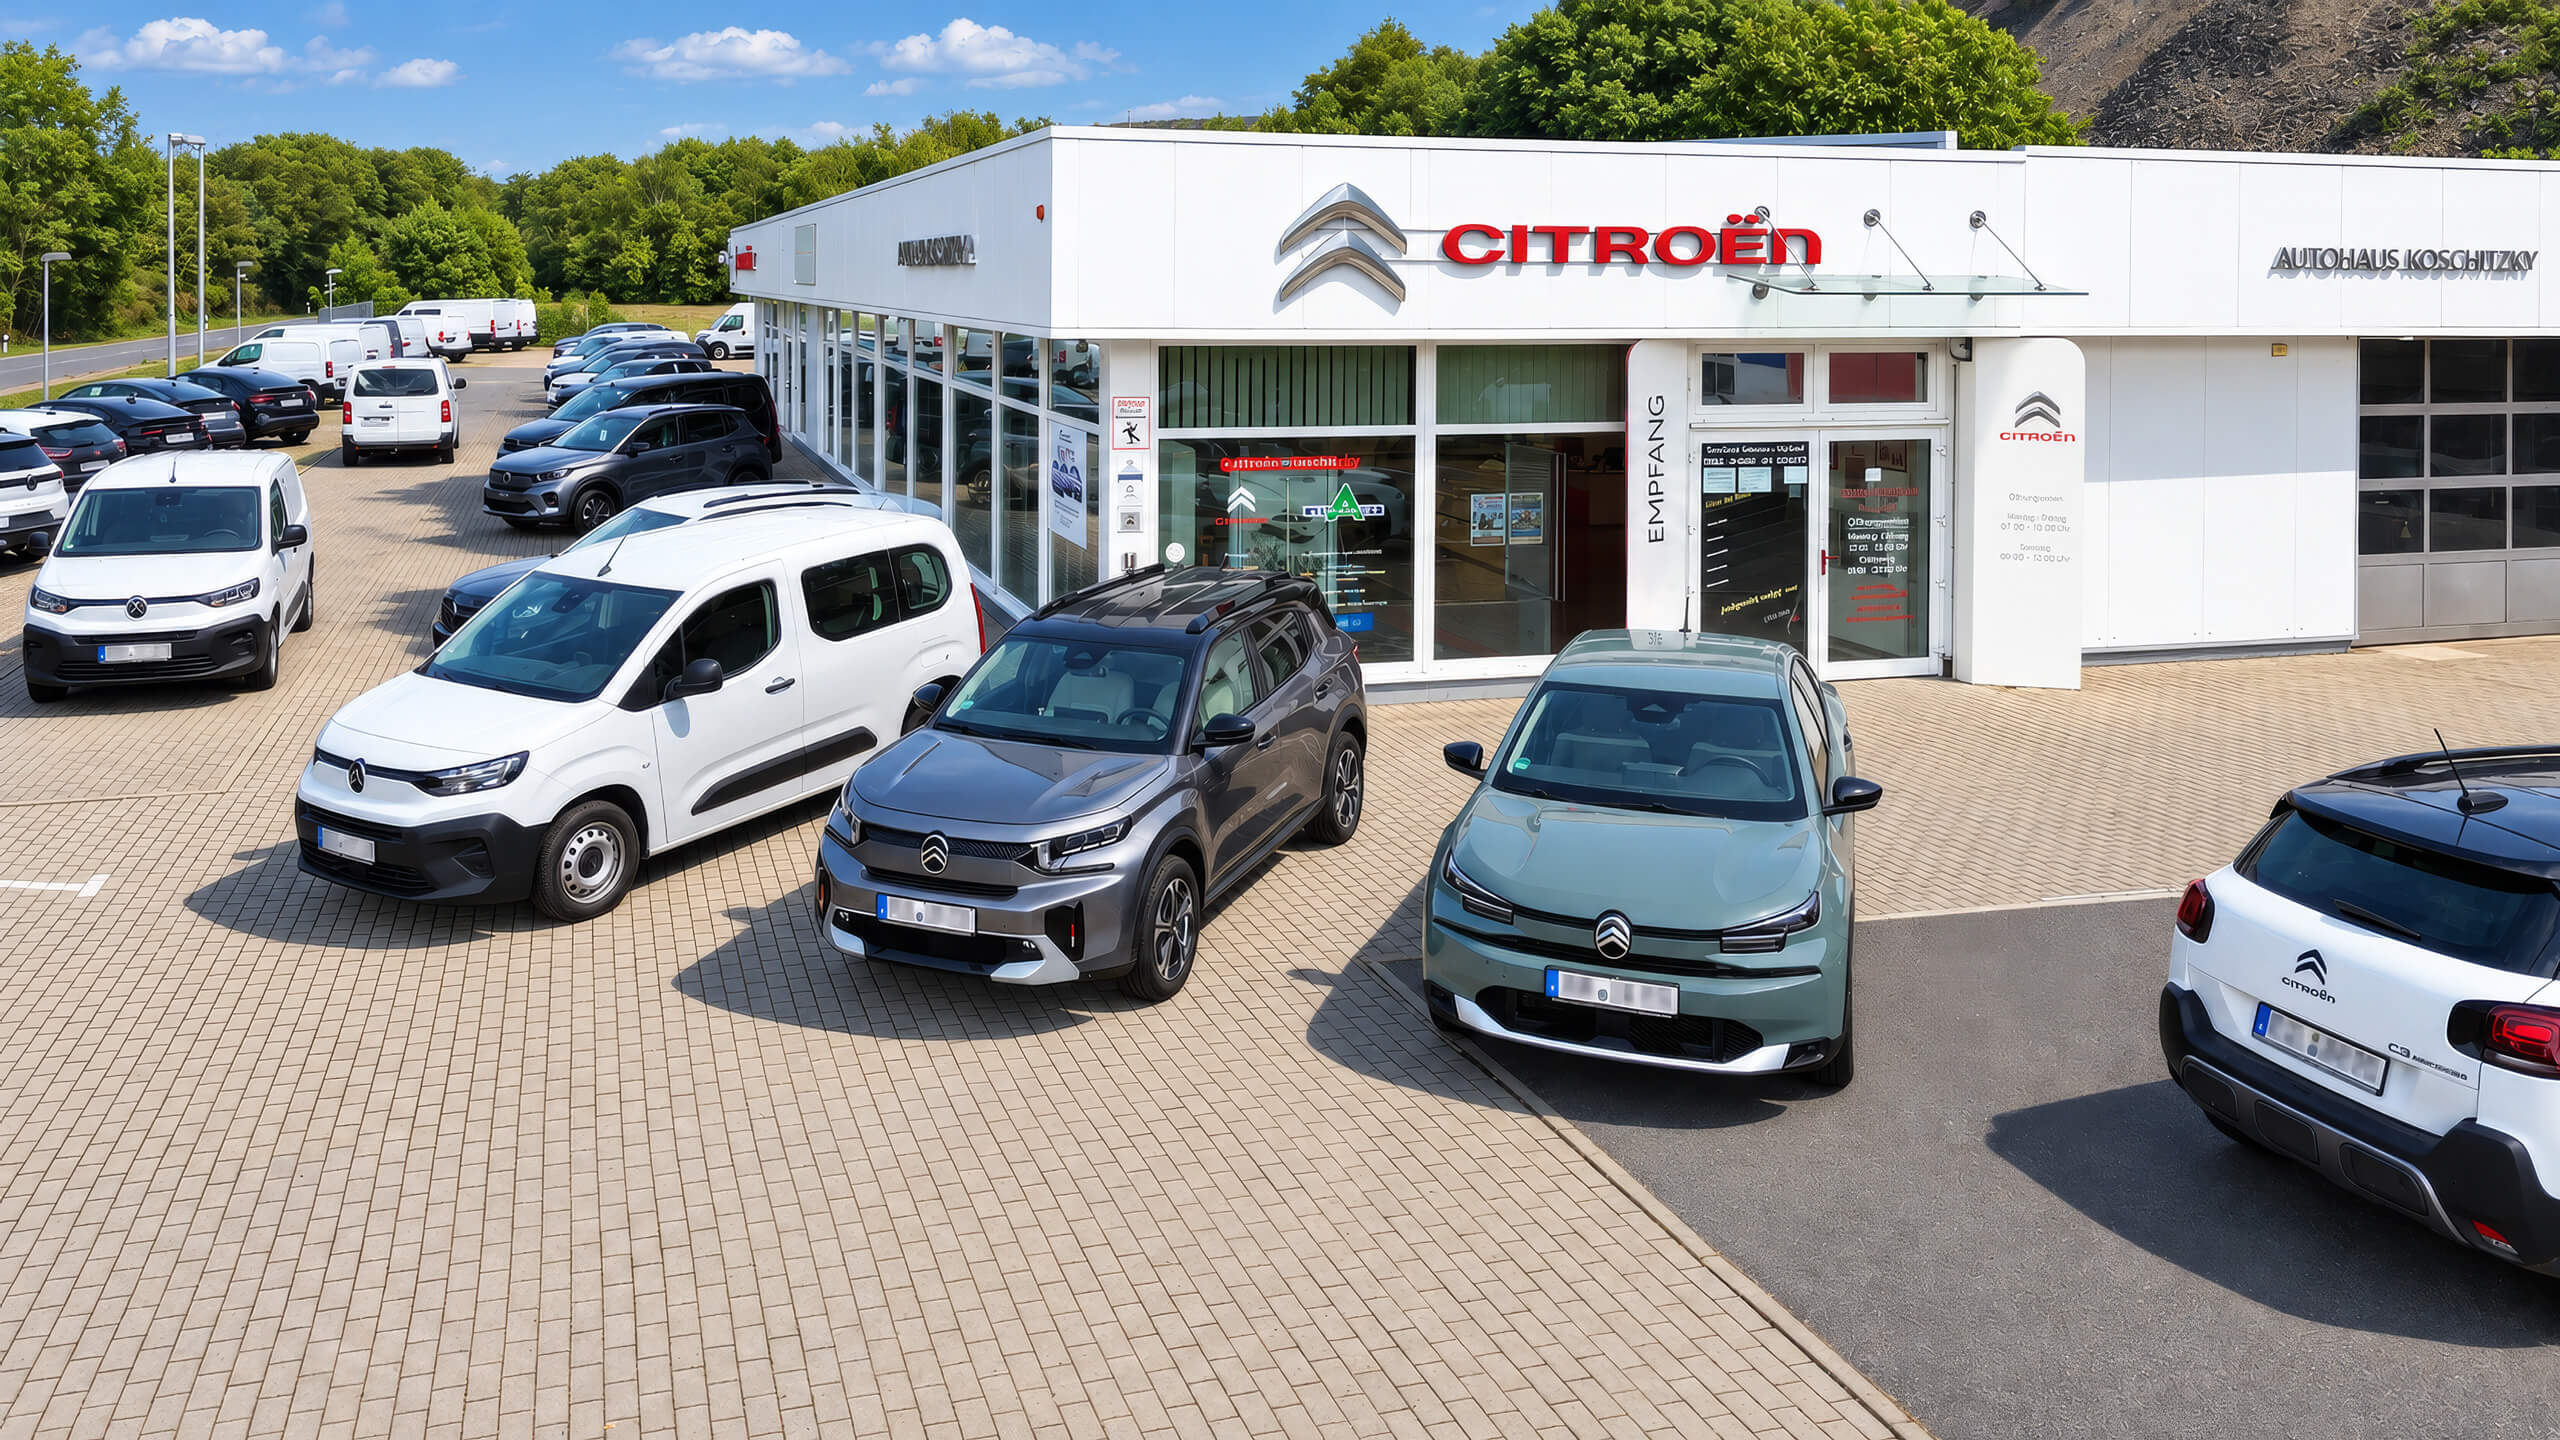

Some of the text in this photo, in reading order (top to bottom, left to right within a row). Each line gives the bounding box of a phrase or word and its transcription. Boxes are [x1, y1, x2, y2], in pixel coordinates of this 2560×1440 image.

[2270, 246, 2540, 272] AUTOHAUS KOSCHITZKY
[1648, 395, 1665, 543] EMPFANG
